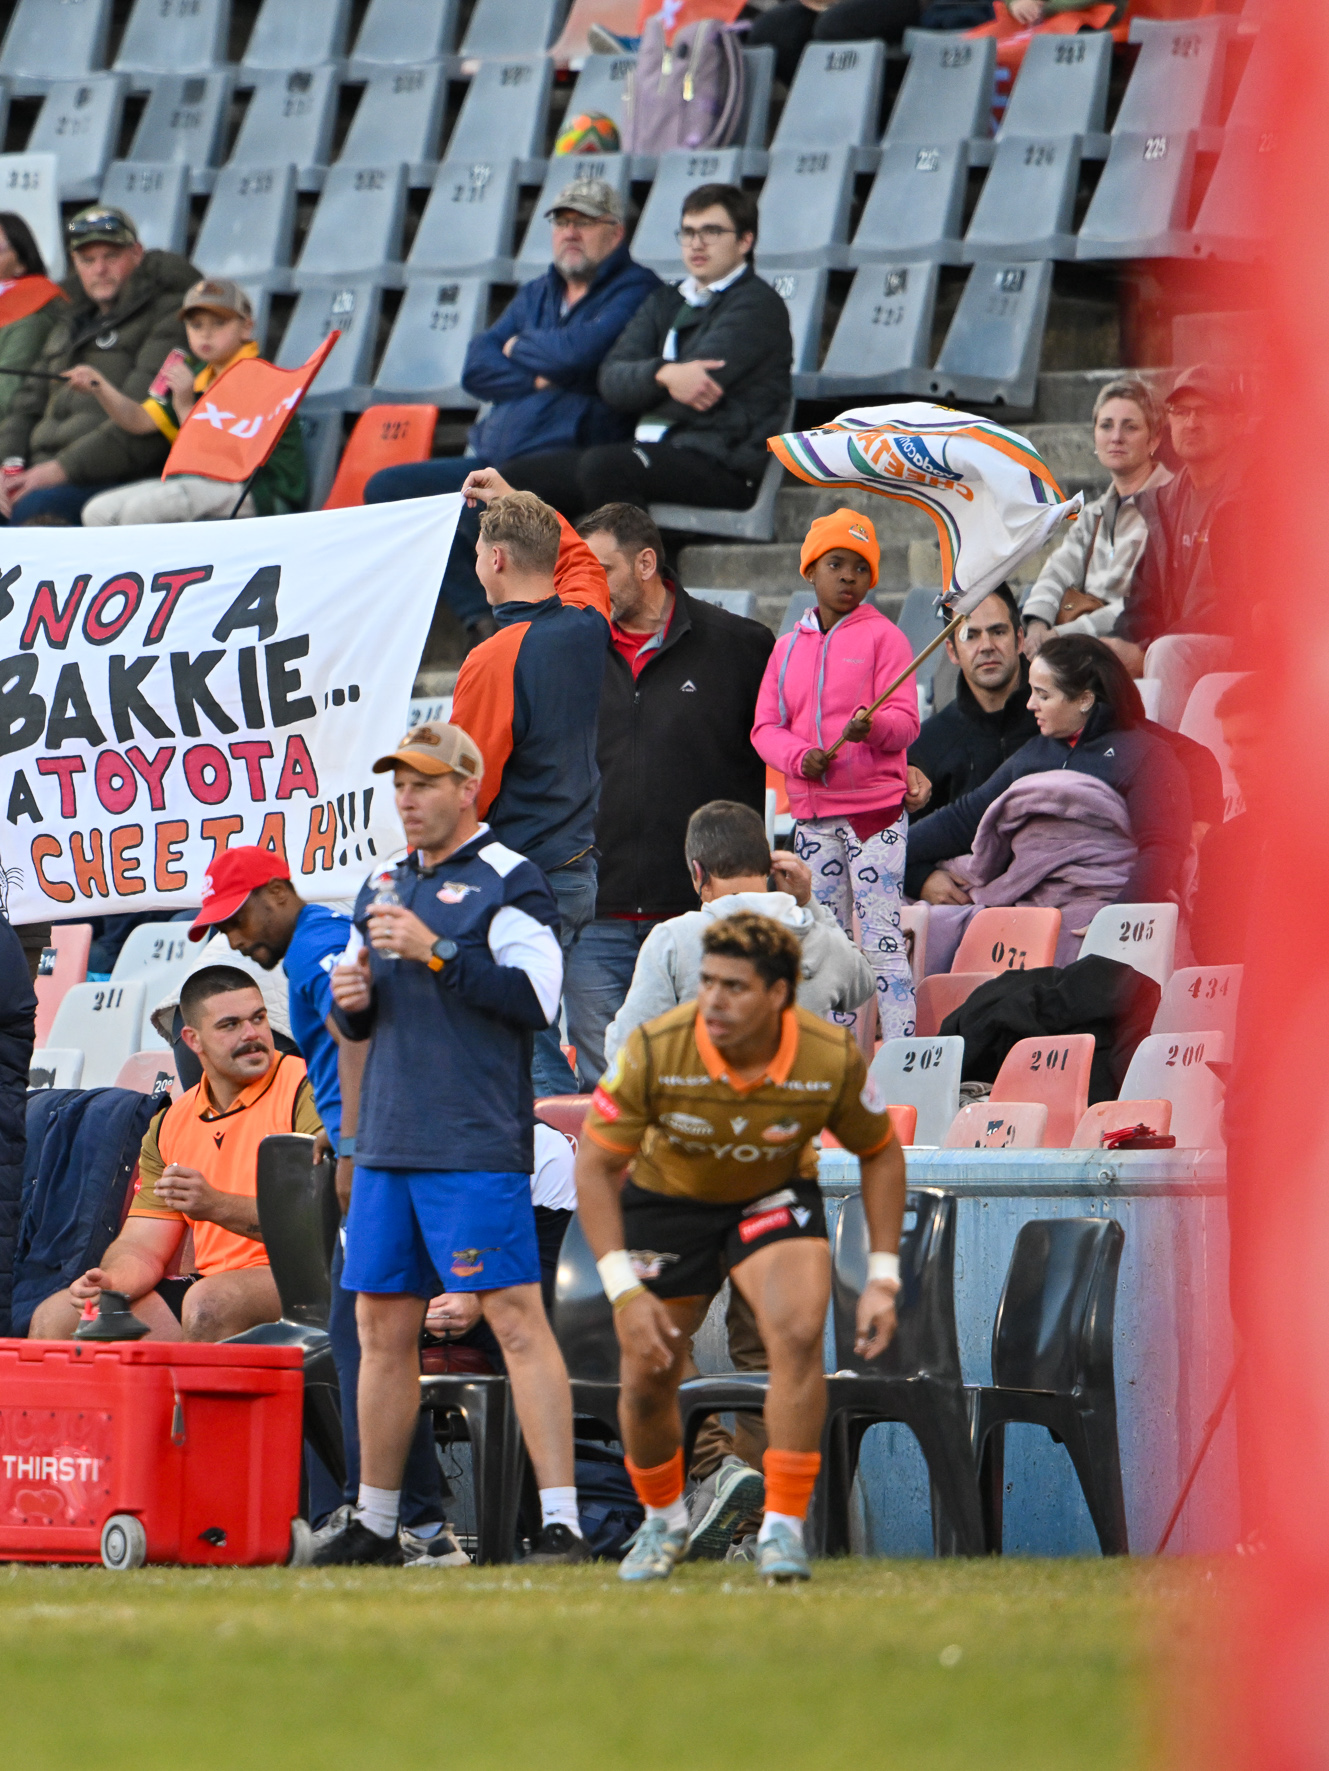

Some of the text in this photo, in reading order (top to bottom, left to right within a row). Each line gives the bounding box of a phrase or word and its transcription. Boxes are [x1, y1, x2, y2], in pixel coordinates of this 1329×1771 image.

[19, 564, 214, 650] NOT
[212, 564, 281, 642] A
[6, 769, 43, 825] A
[36, 735, 318, 818] TOYOTA
[1119, 919, 1156, 943] 205
[94, 988, 124, 1011] 211
[903, 1045, 943, 1073] 202
[1030, 1048, 1069, 1071] 201
[1165, 1043, 1204, 1067] 200
[2, 1455, 99, 1482] THIRSTI
